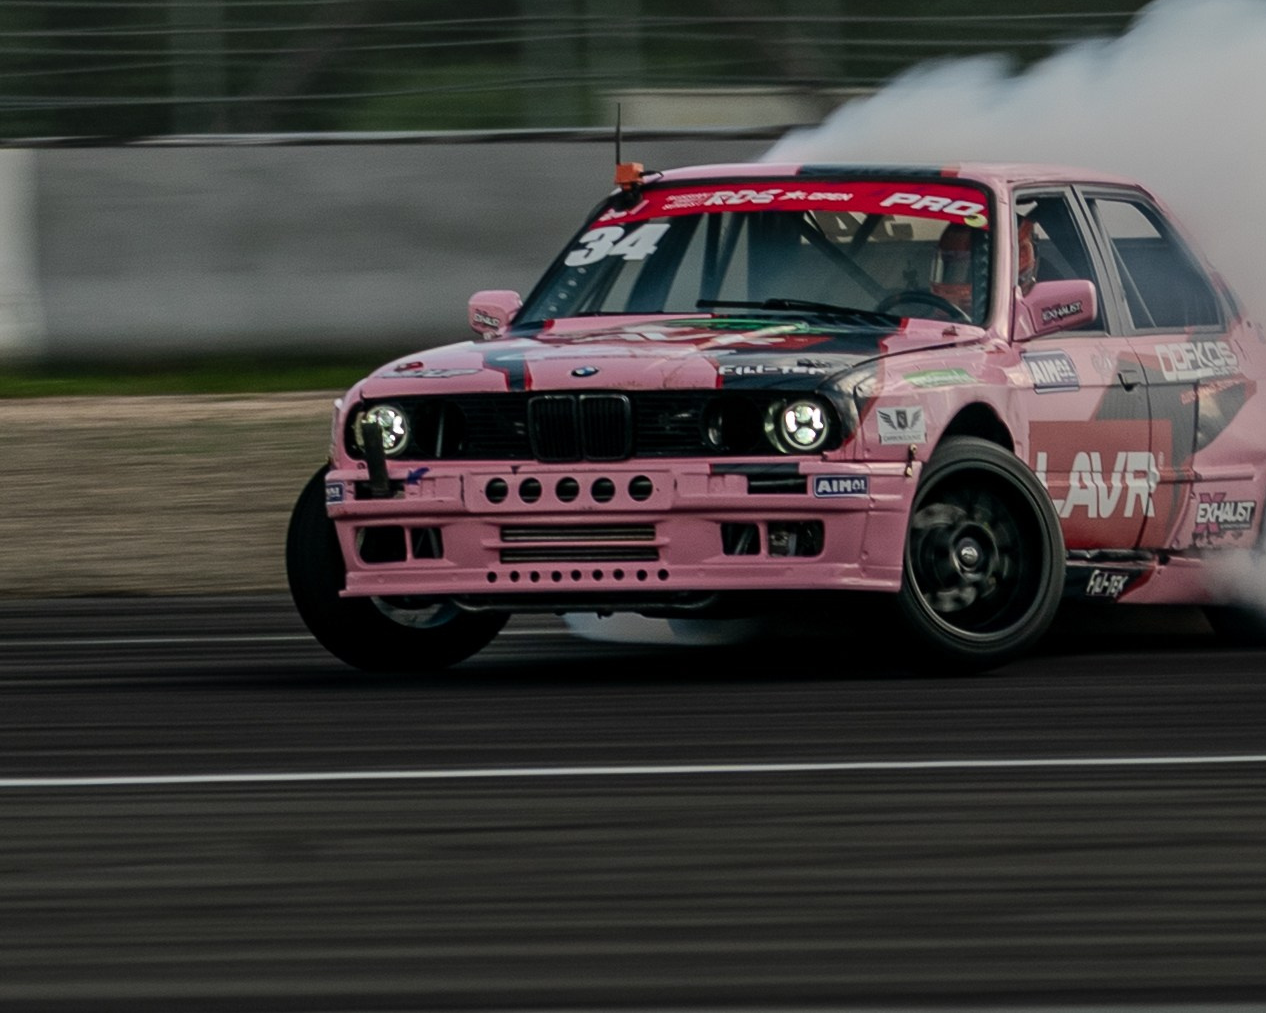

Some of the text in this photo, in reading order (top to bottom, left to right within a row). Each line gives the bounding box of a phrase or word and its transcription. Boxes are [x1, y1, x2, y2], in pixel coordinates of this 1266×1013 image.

[879, 192, 985, 216] PRO
[564, 223, 671, 267] 34
[1035, 451, 1160, 519] LAVR
[1196, 500, 1255, 524] EXHAUST
